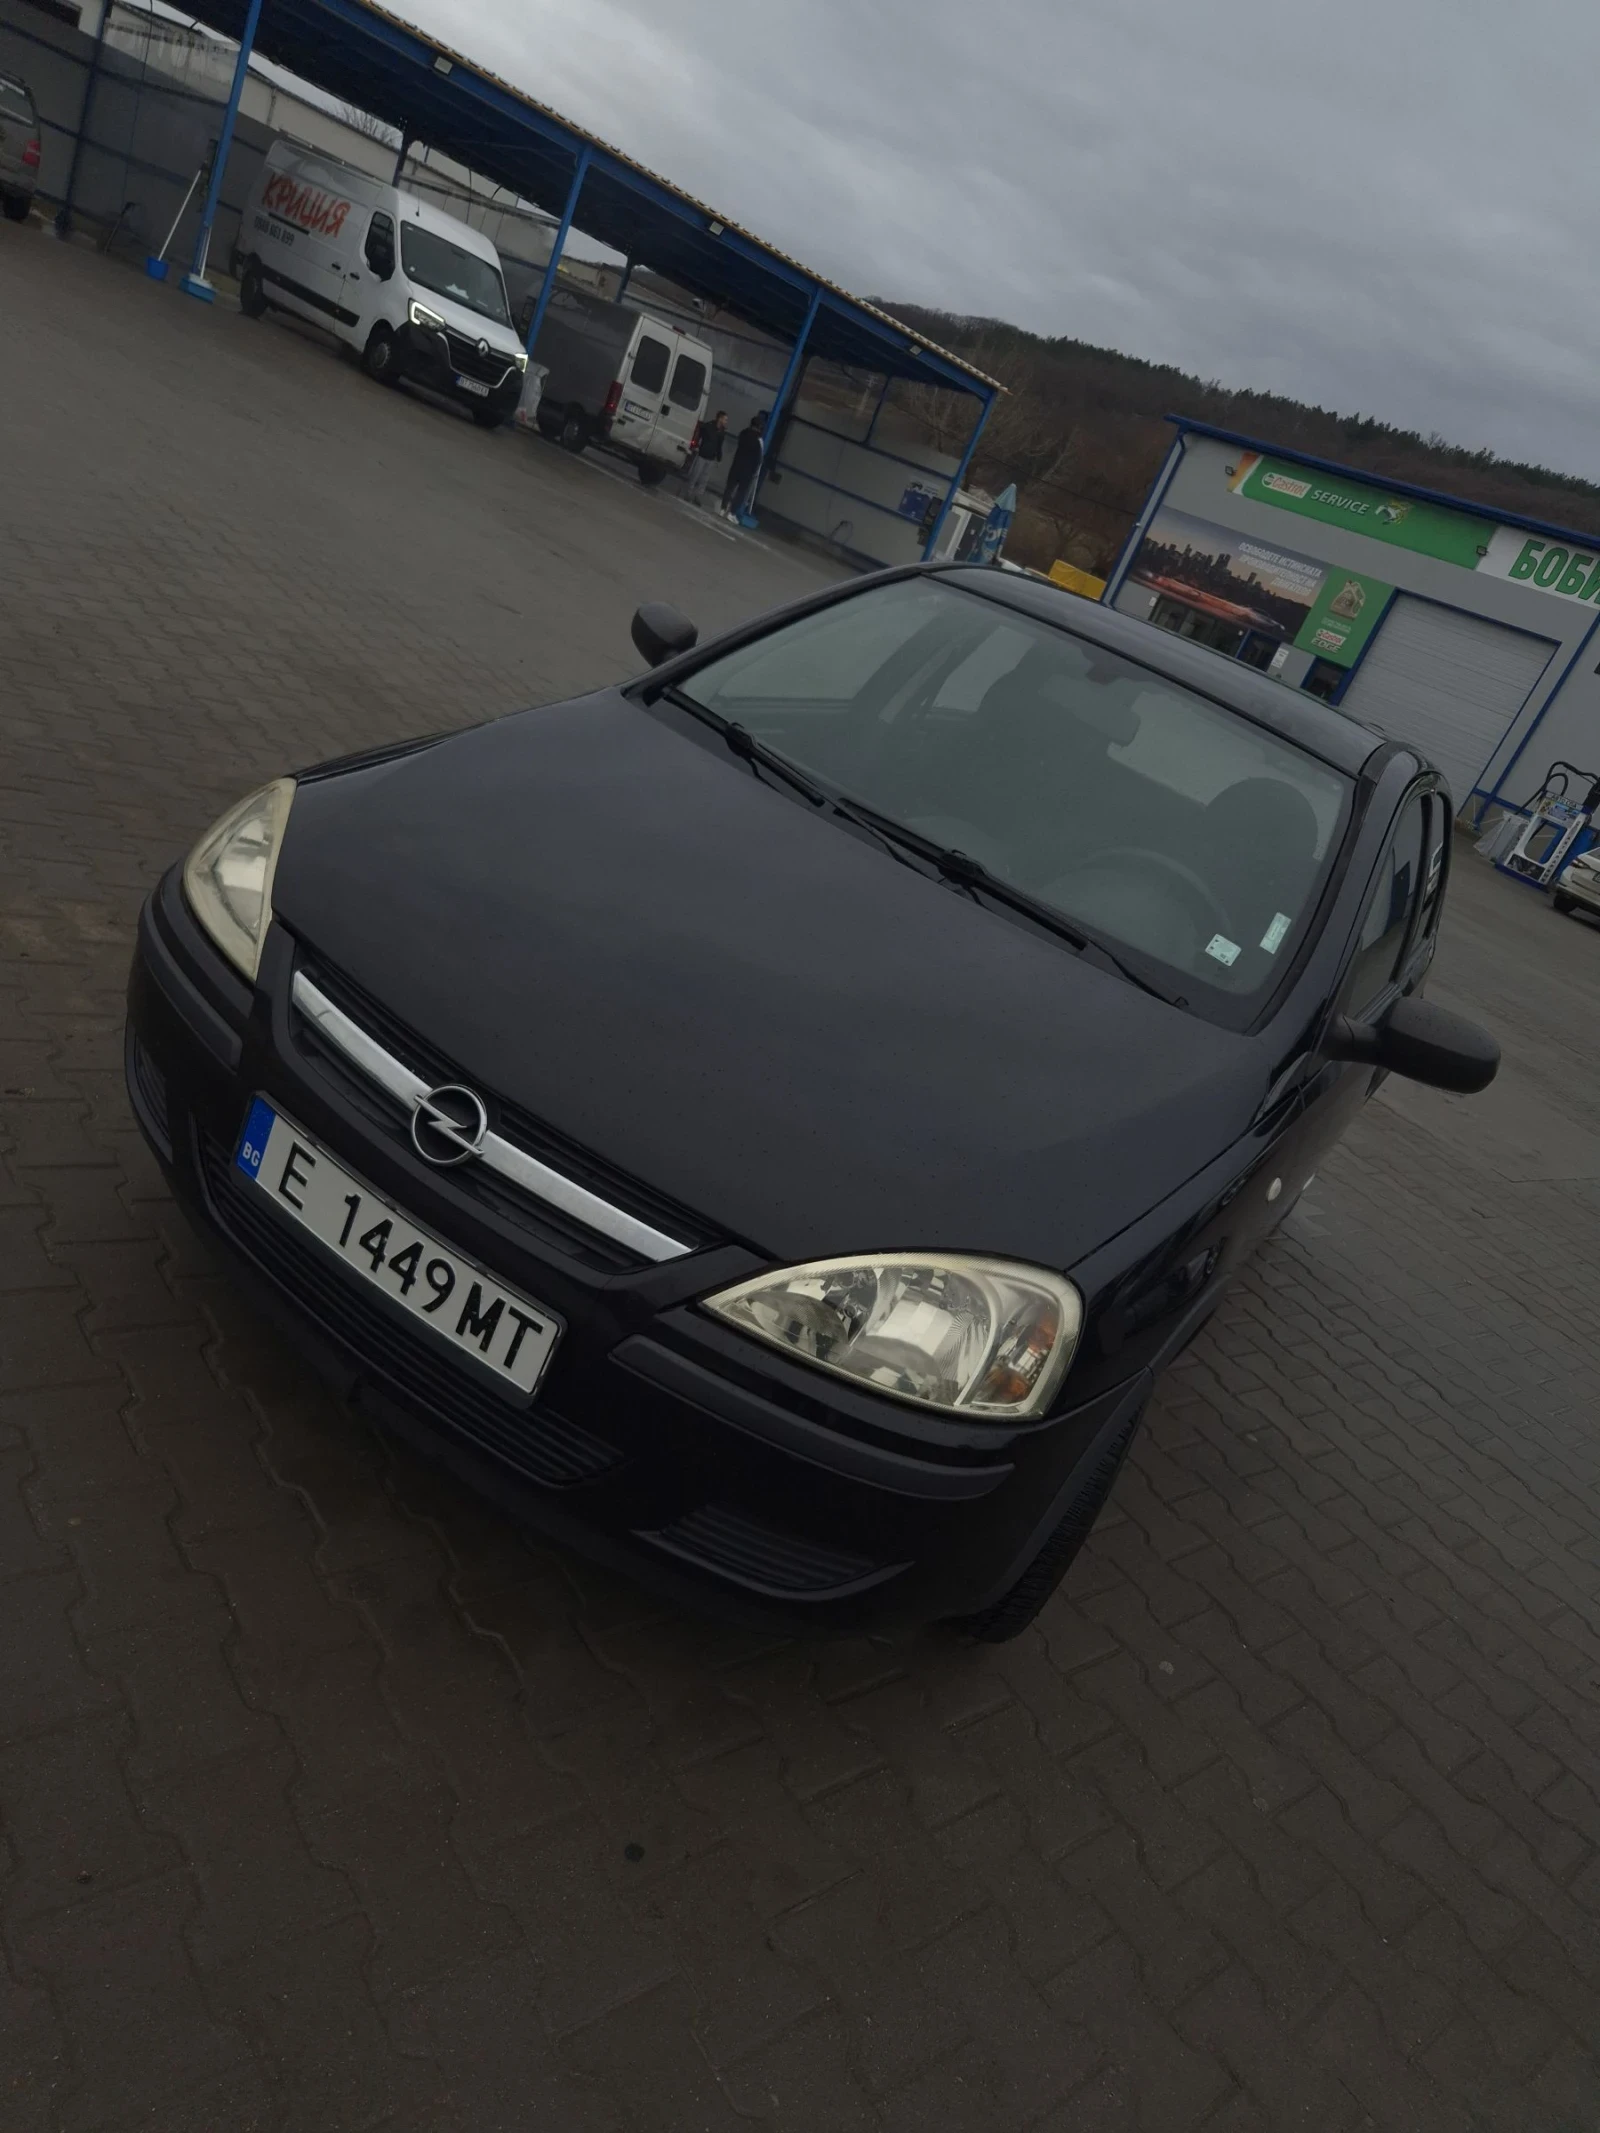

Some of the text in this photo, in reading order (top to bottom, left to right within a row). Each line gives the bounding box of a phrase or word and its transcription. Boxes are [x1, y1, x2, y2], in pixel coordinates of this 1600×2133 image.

[262, 172, 351, 240] КРИЦИЯ
[1271, 476, 1370, 515] Castrol SERVICE
[1311, 637, 1342, 654] EDGE
[241, 1141, 261, 1167] BG
[278, 1139, 544, 1370] E 1449 MT
